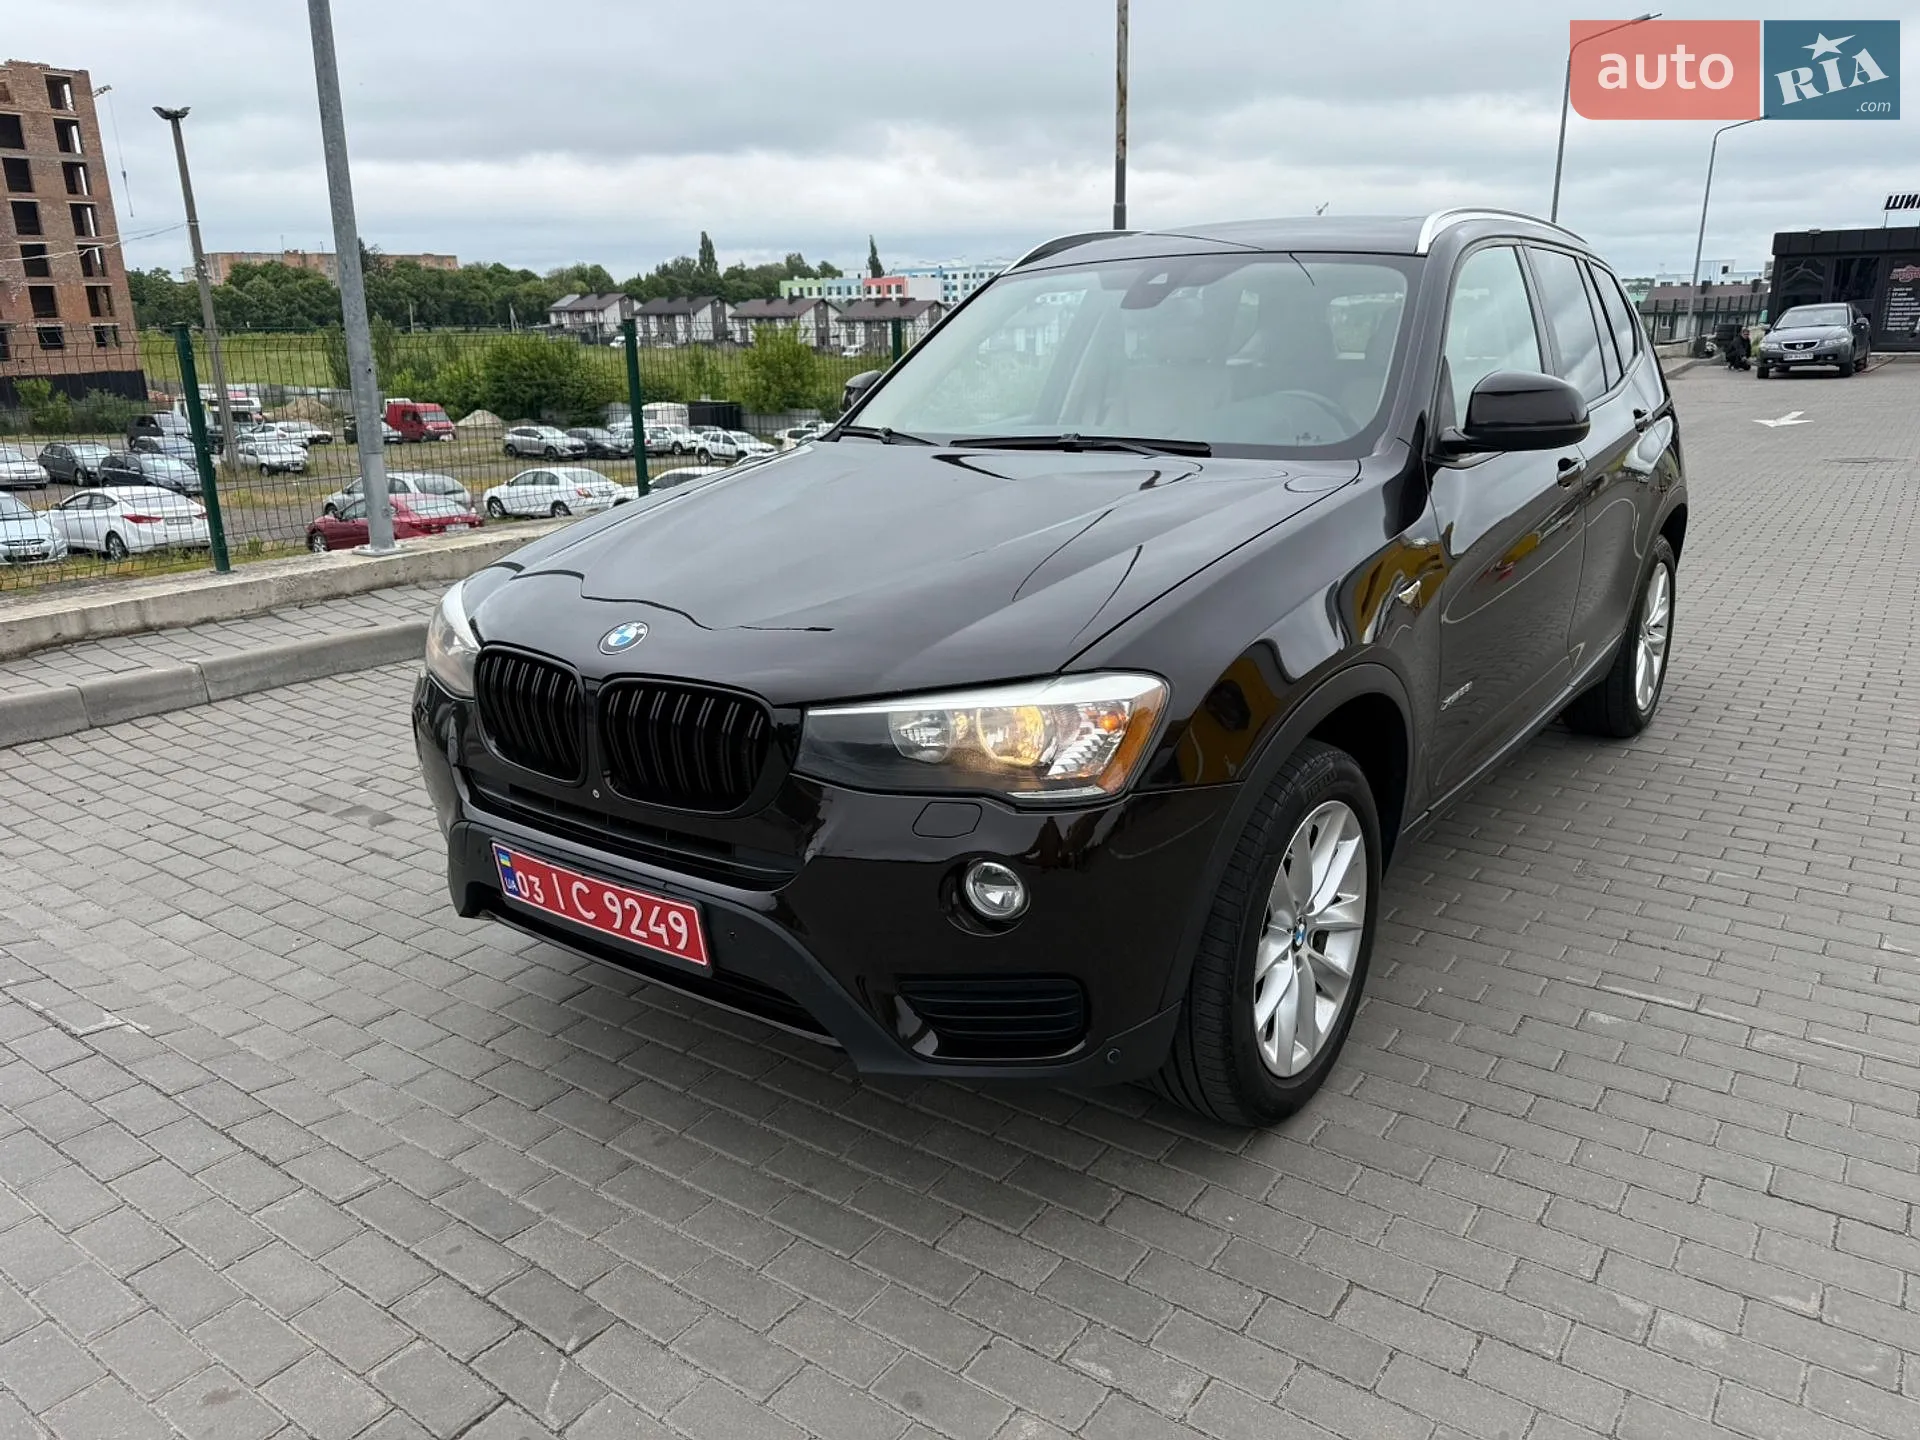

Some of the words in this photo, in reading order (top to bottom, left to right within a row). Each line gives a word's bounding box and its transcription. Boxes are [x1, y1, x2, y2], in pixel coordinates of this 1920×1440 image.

[1884, 194, 1920, 210] ШИ
[504, 877, 518, 891] UA
[515, 871, 544, 904] 03
[603, 891, 688, 950] 9249
